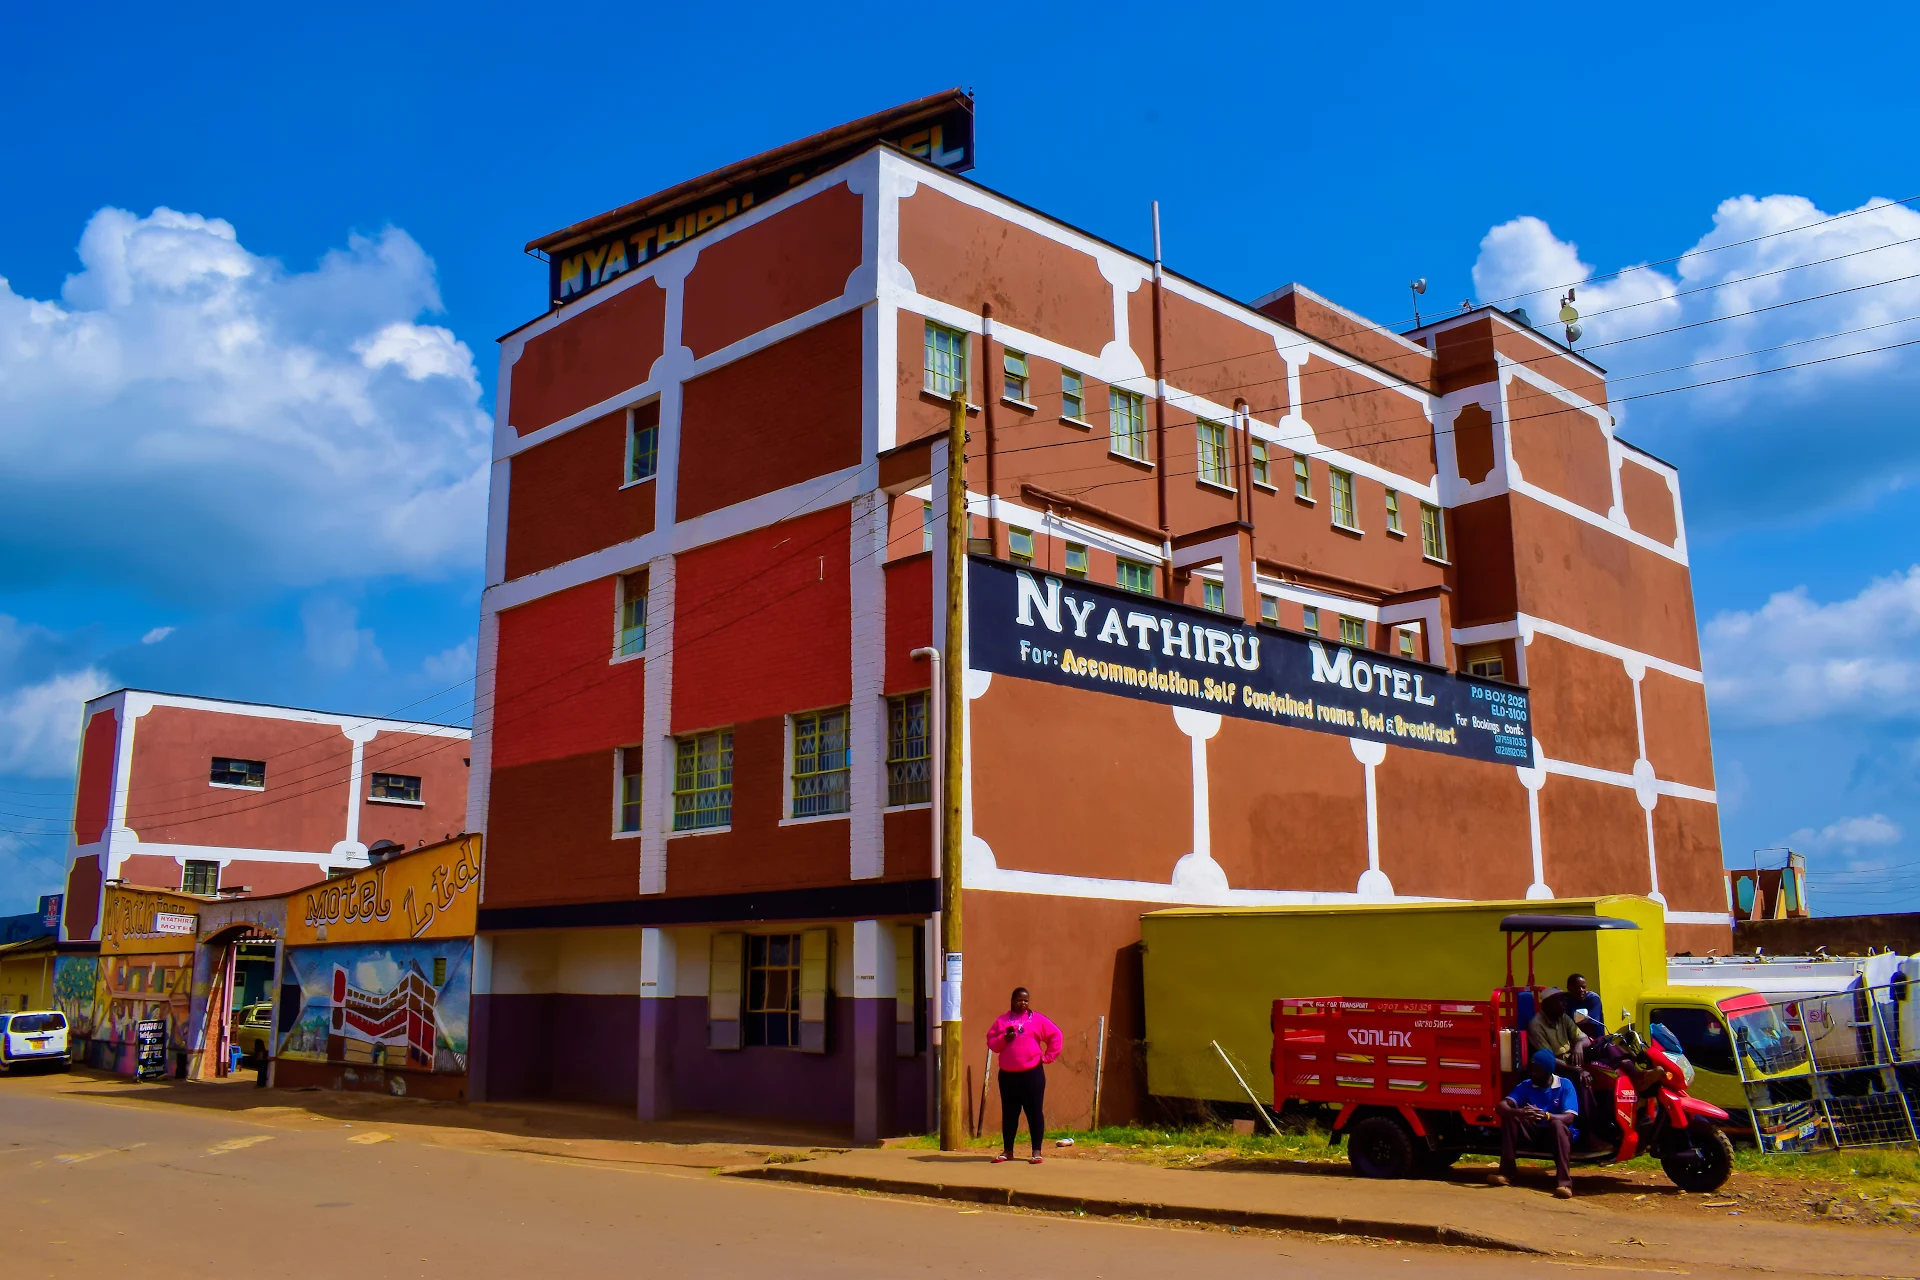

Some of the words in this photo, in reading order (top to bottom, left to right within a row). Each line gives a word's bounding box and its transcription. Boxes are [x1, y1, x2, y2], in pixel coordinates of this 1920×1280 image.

[1015, 569, 1260, 671] NYATHIRU
[1308, 639, 1435, 706] MOTEL
[1020, 639, 1058, 666] For:
[1485, 689, 1507, 704] BOX
[1507, 694, 1526, 709] 2021
[1455, 713, 1468, 727] For
[1472, 715, 1500, 735] Bookings
[403, 838, 480, 938] Ltd
[160, 916, 195, 925] NYATHIRU
[160, 924, 195, 932] MOTEL
